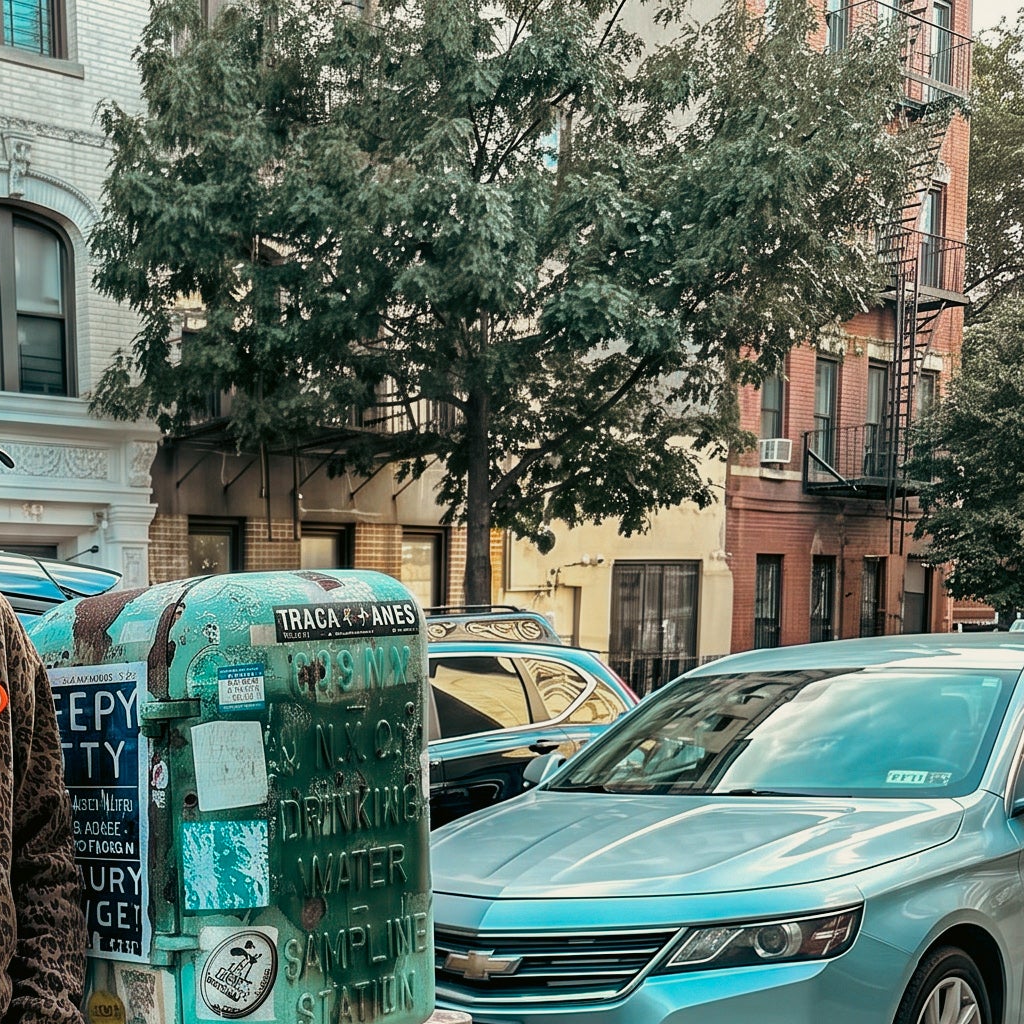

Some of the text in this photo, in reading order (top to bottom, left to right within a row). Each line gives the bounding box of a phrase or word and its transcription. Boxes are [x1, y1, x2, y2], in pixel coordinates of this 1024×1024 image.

[276, 603, 415, 631] TRACA ANES
[297, 843, 407, 897] WATER
